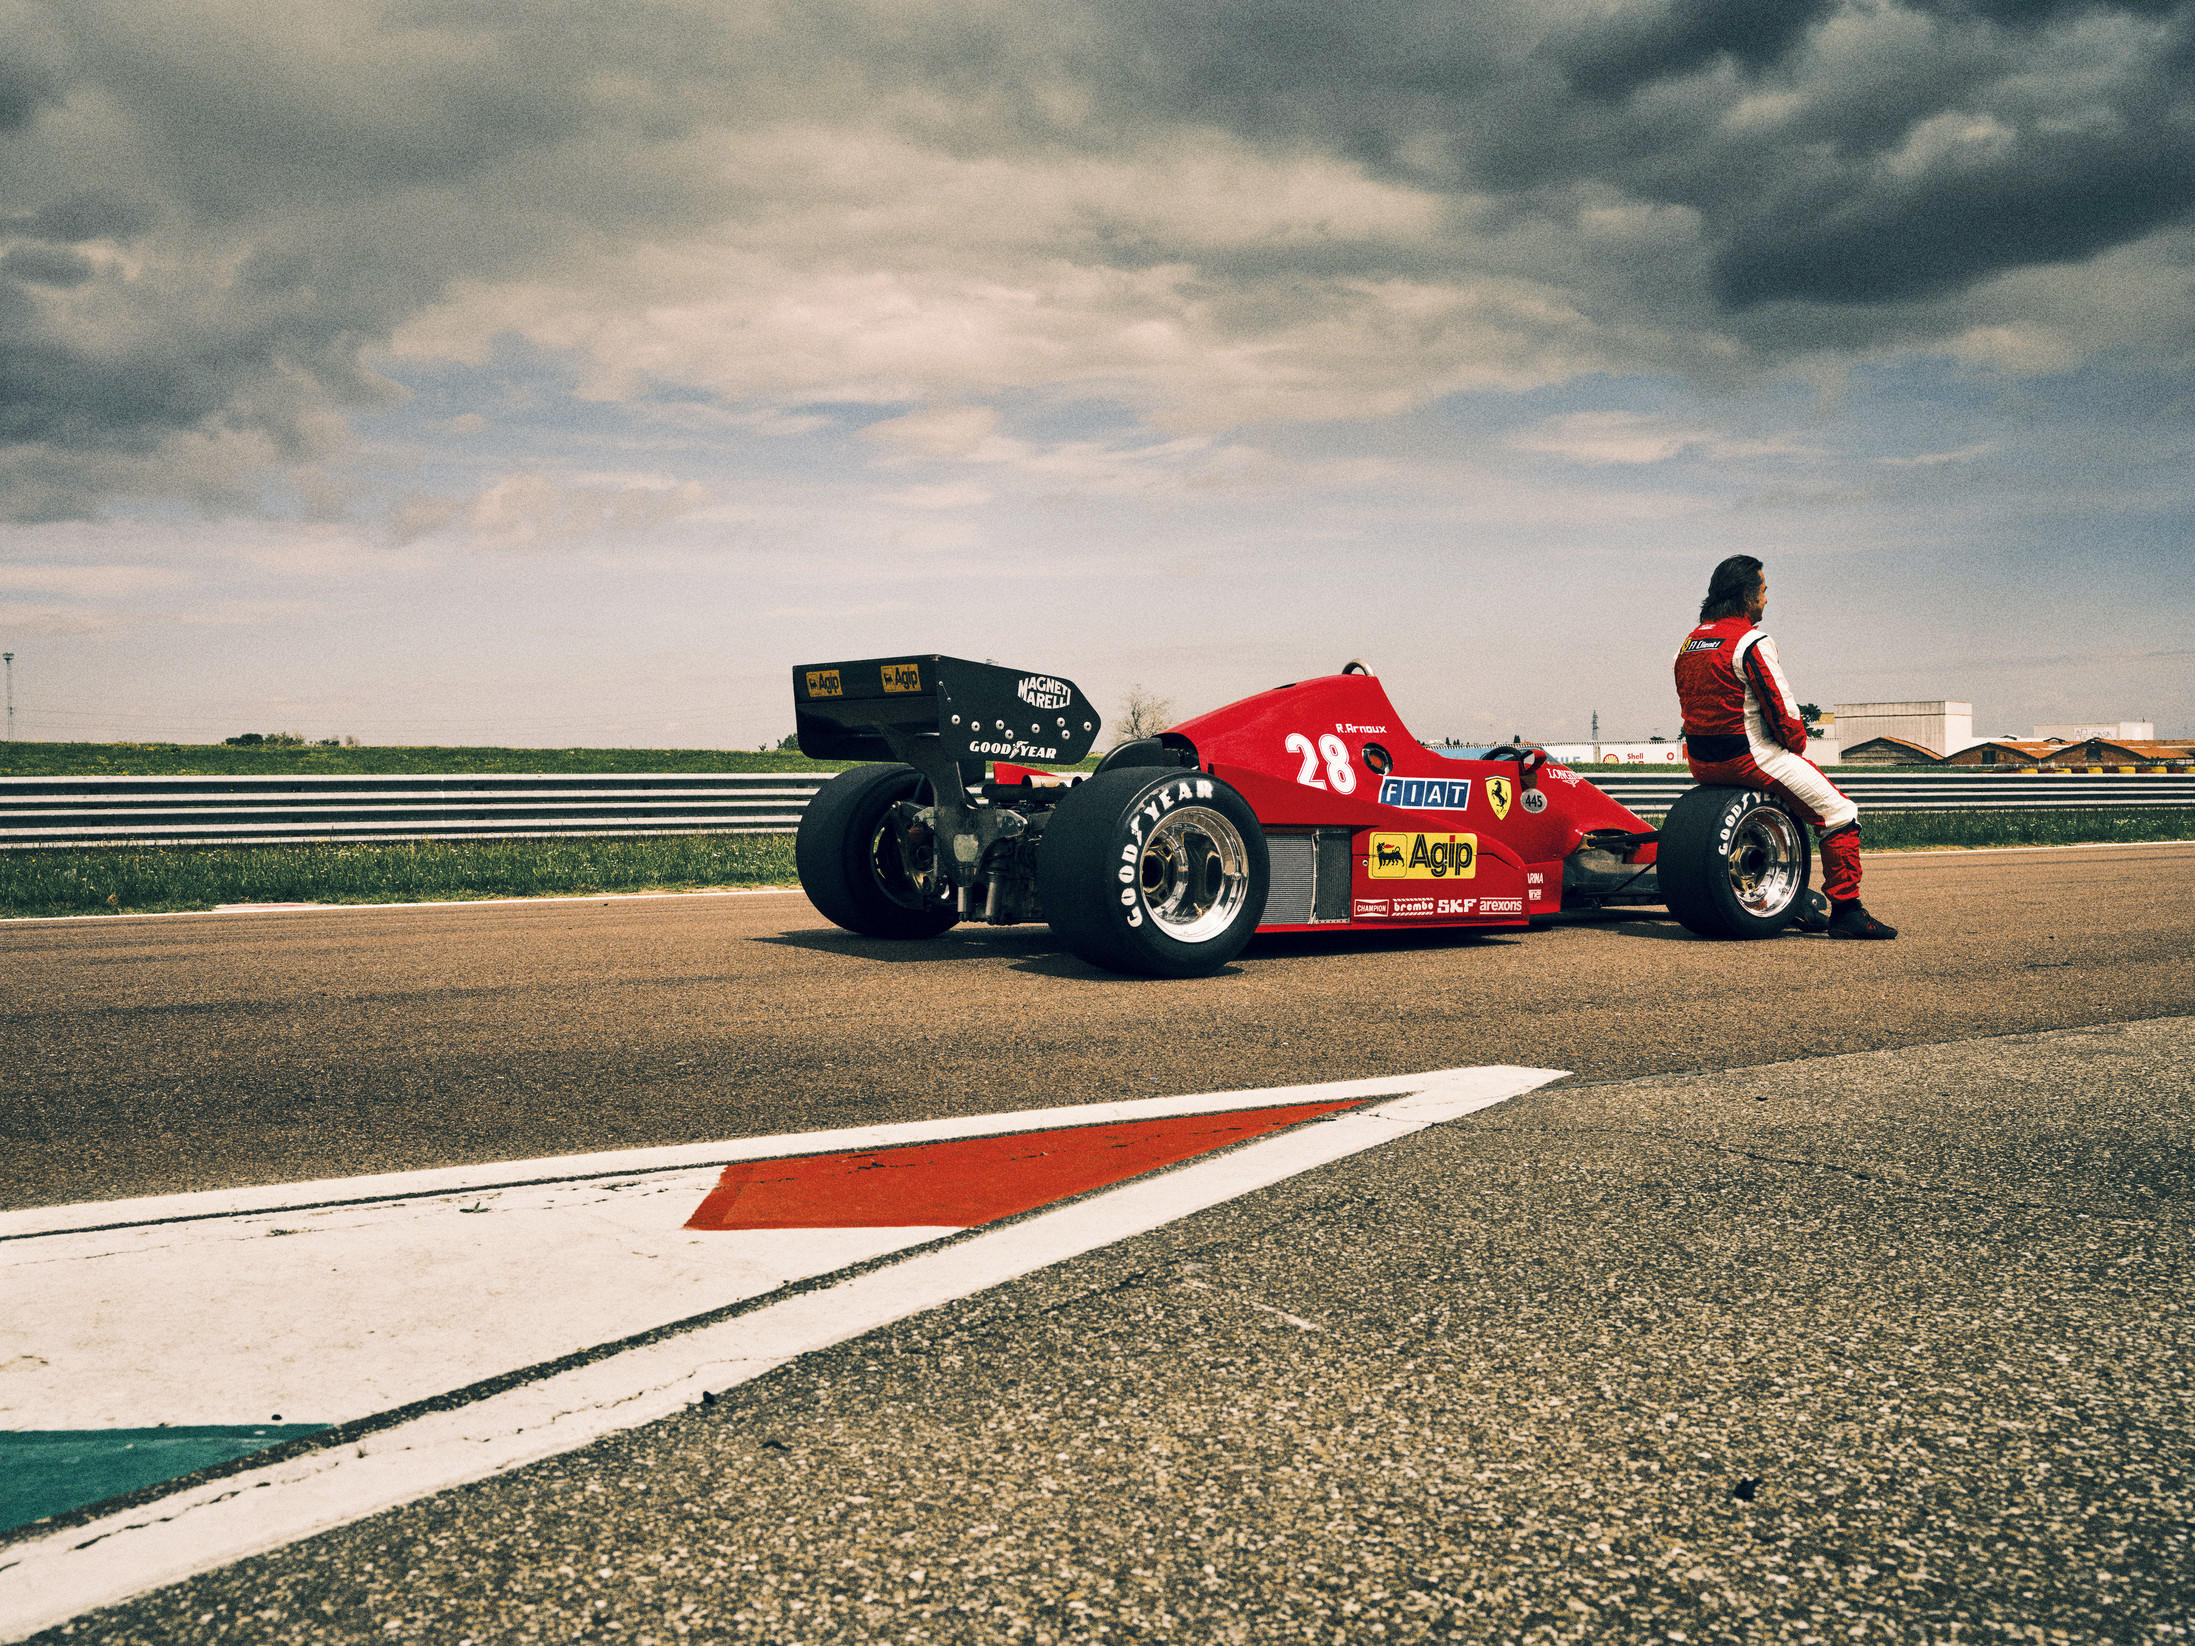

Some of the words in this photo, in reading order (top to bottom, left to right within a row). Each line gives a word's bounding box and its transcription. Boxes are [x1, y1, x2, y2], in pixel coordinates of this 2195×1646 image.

[818, 672, 840, 694] Agip
[895, 666, 918, 690] Agip
[1018, 676, 1071, 700] MAGNETI
[1018, 682, 1071, 709] MARELLI
[1284, 733, 1356, 795] 28
[1627, 752, 1644, 760] Shell
[1385, 783, 1465, 805] FIAT
[1525, 794, 1543, 808] 445
[1408, 834, 1473, 878] Agip
[1357, 904, 1386, 912] CHAMPION
[1394, 902, 1433, 911] brembo
[1437, 899, 1477, 913] SKF
[1479, 901, 1522, 911] arexons
